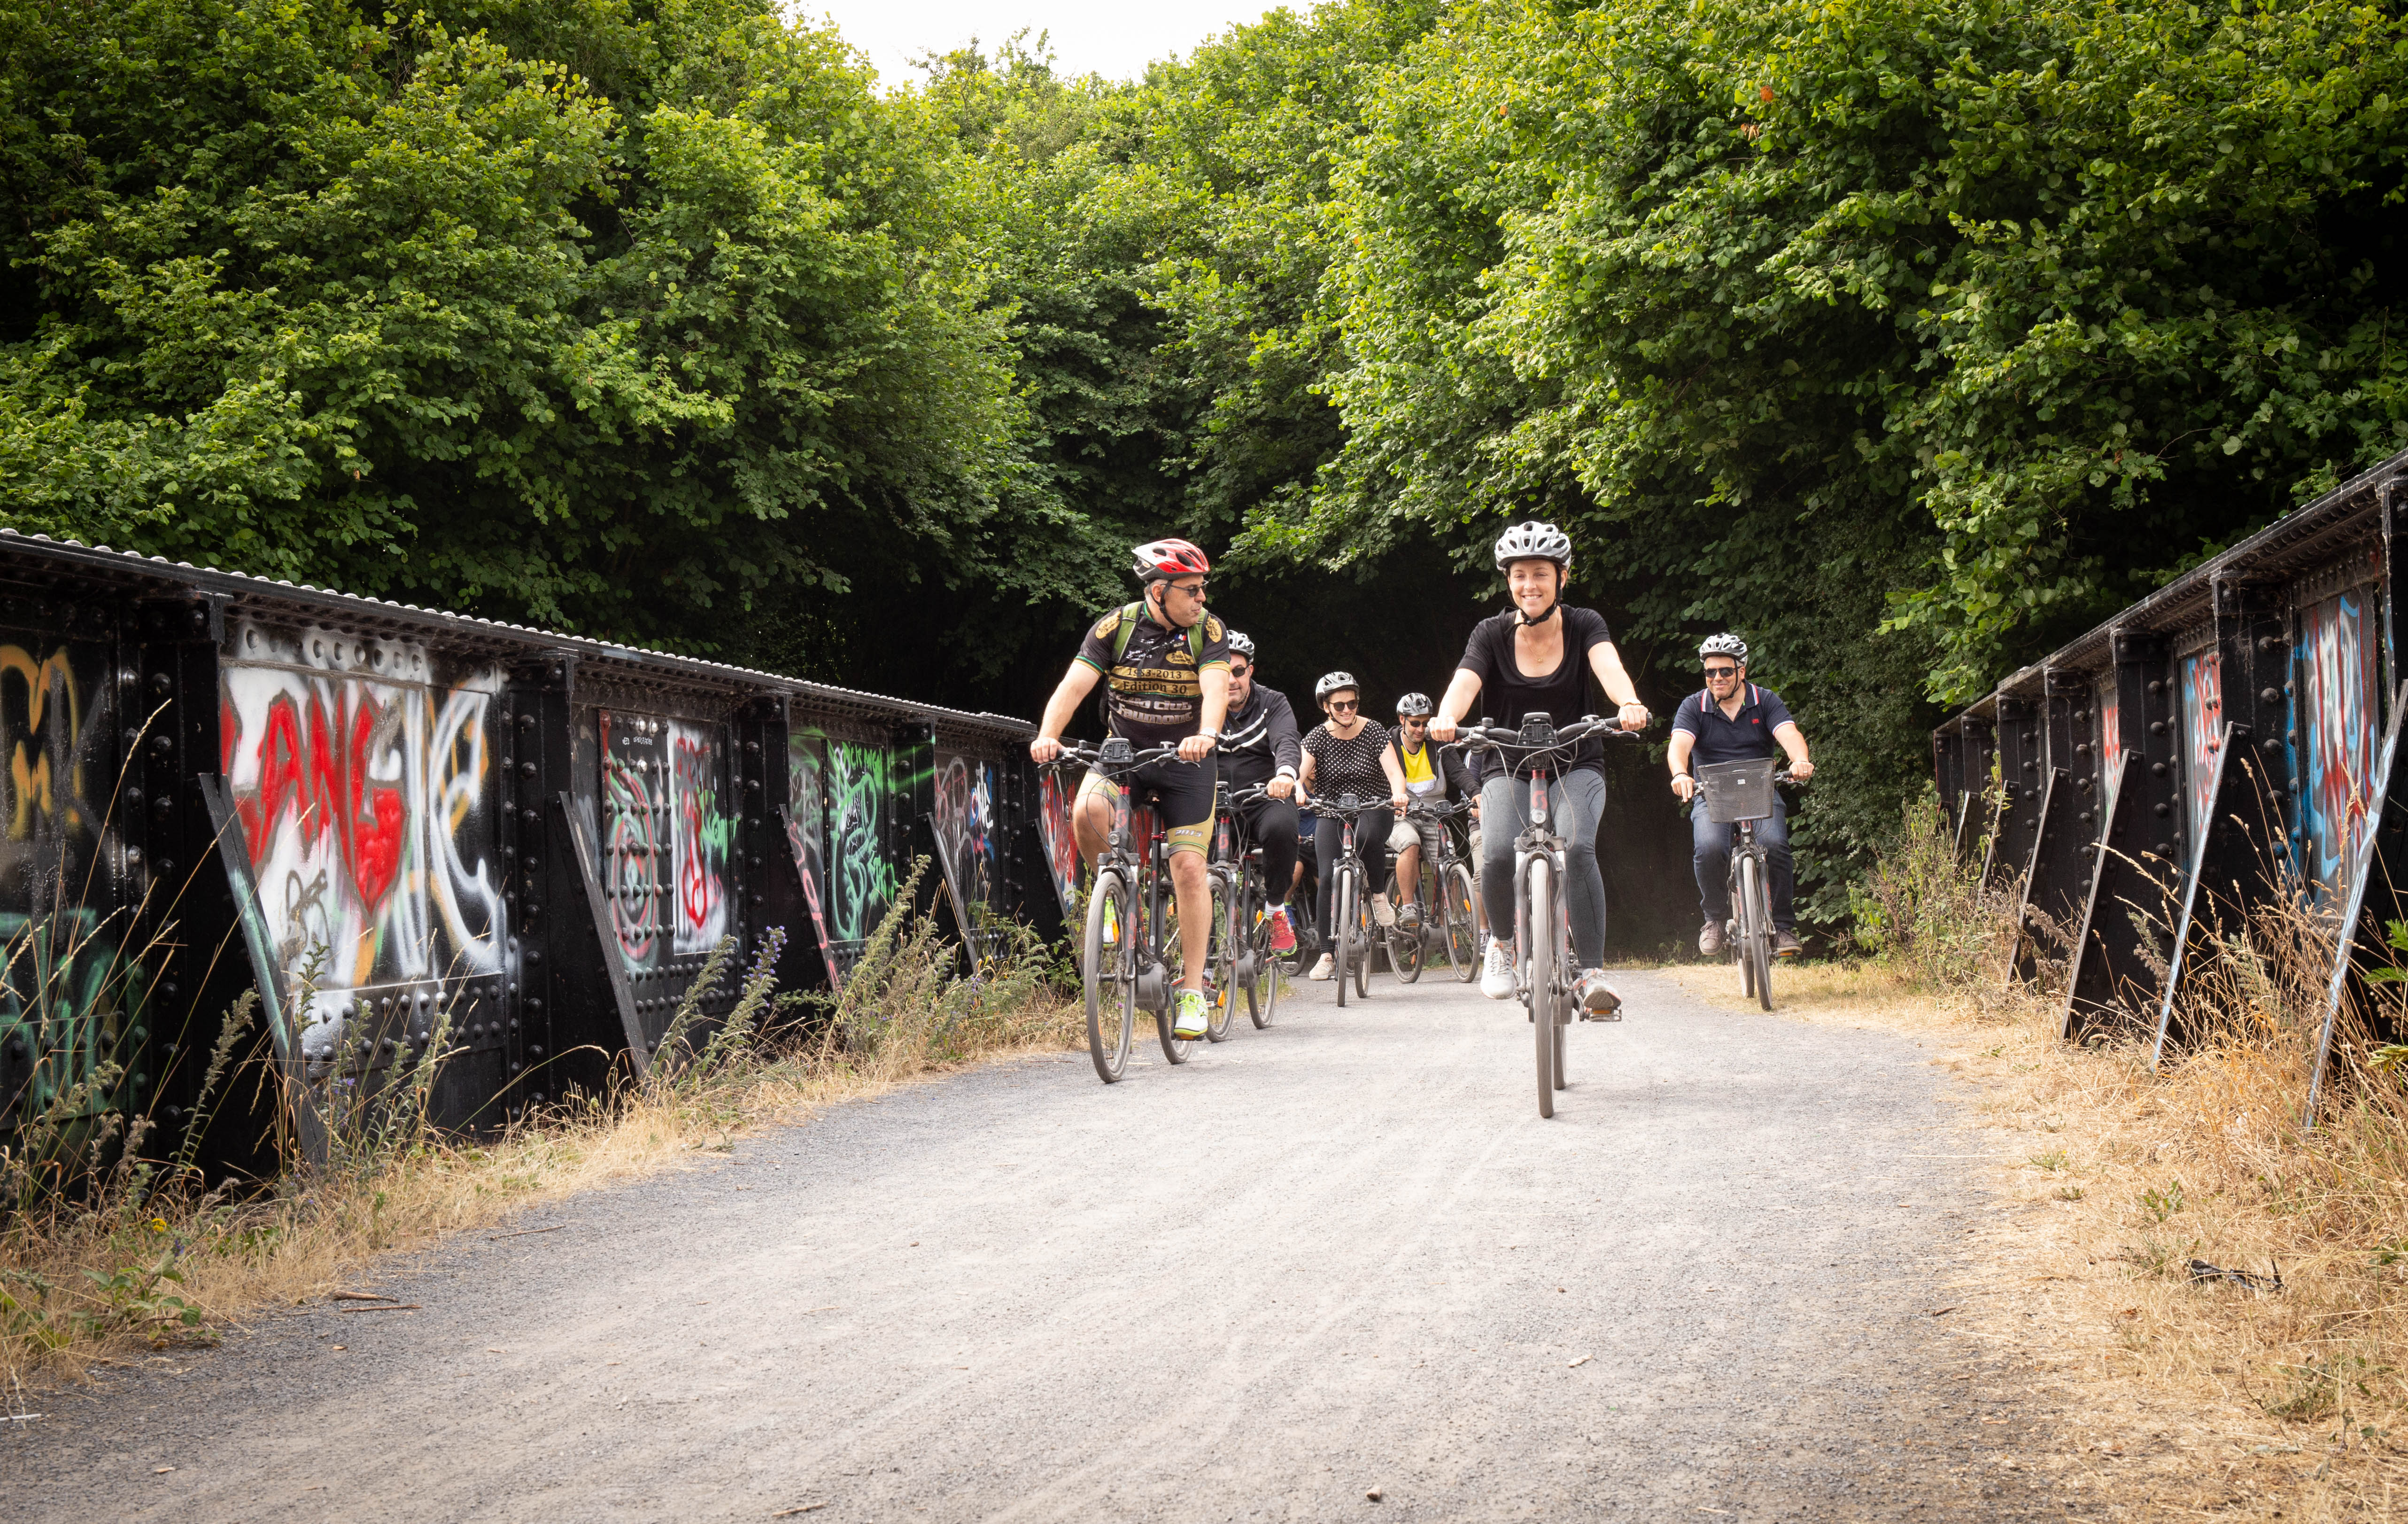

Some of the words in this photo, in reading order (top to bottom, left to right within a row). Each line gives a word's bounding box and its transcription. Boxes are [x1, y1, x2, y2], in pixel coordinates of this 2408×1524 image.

[1123, 681, 1167, 692] Edition
[1171, 684, 1187, 694] 30
[1117, 703, 1193, 724] Faumont
